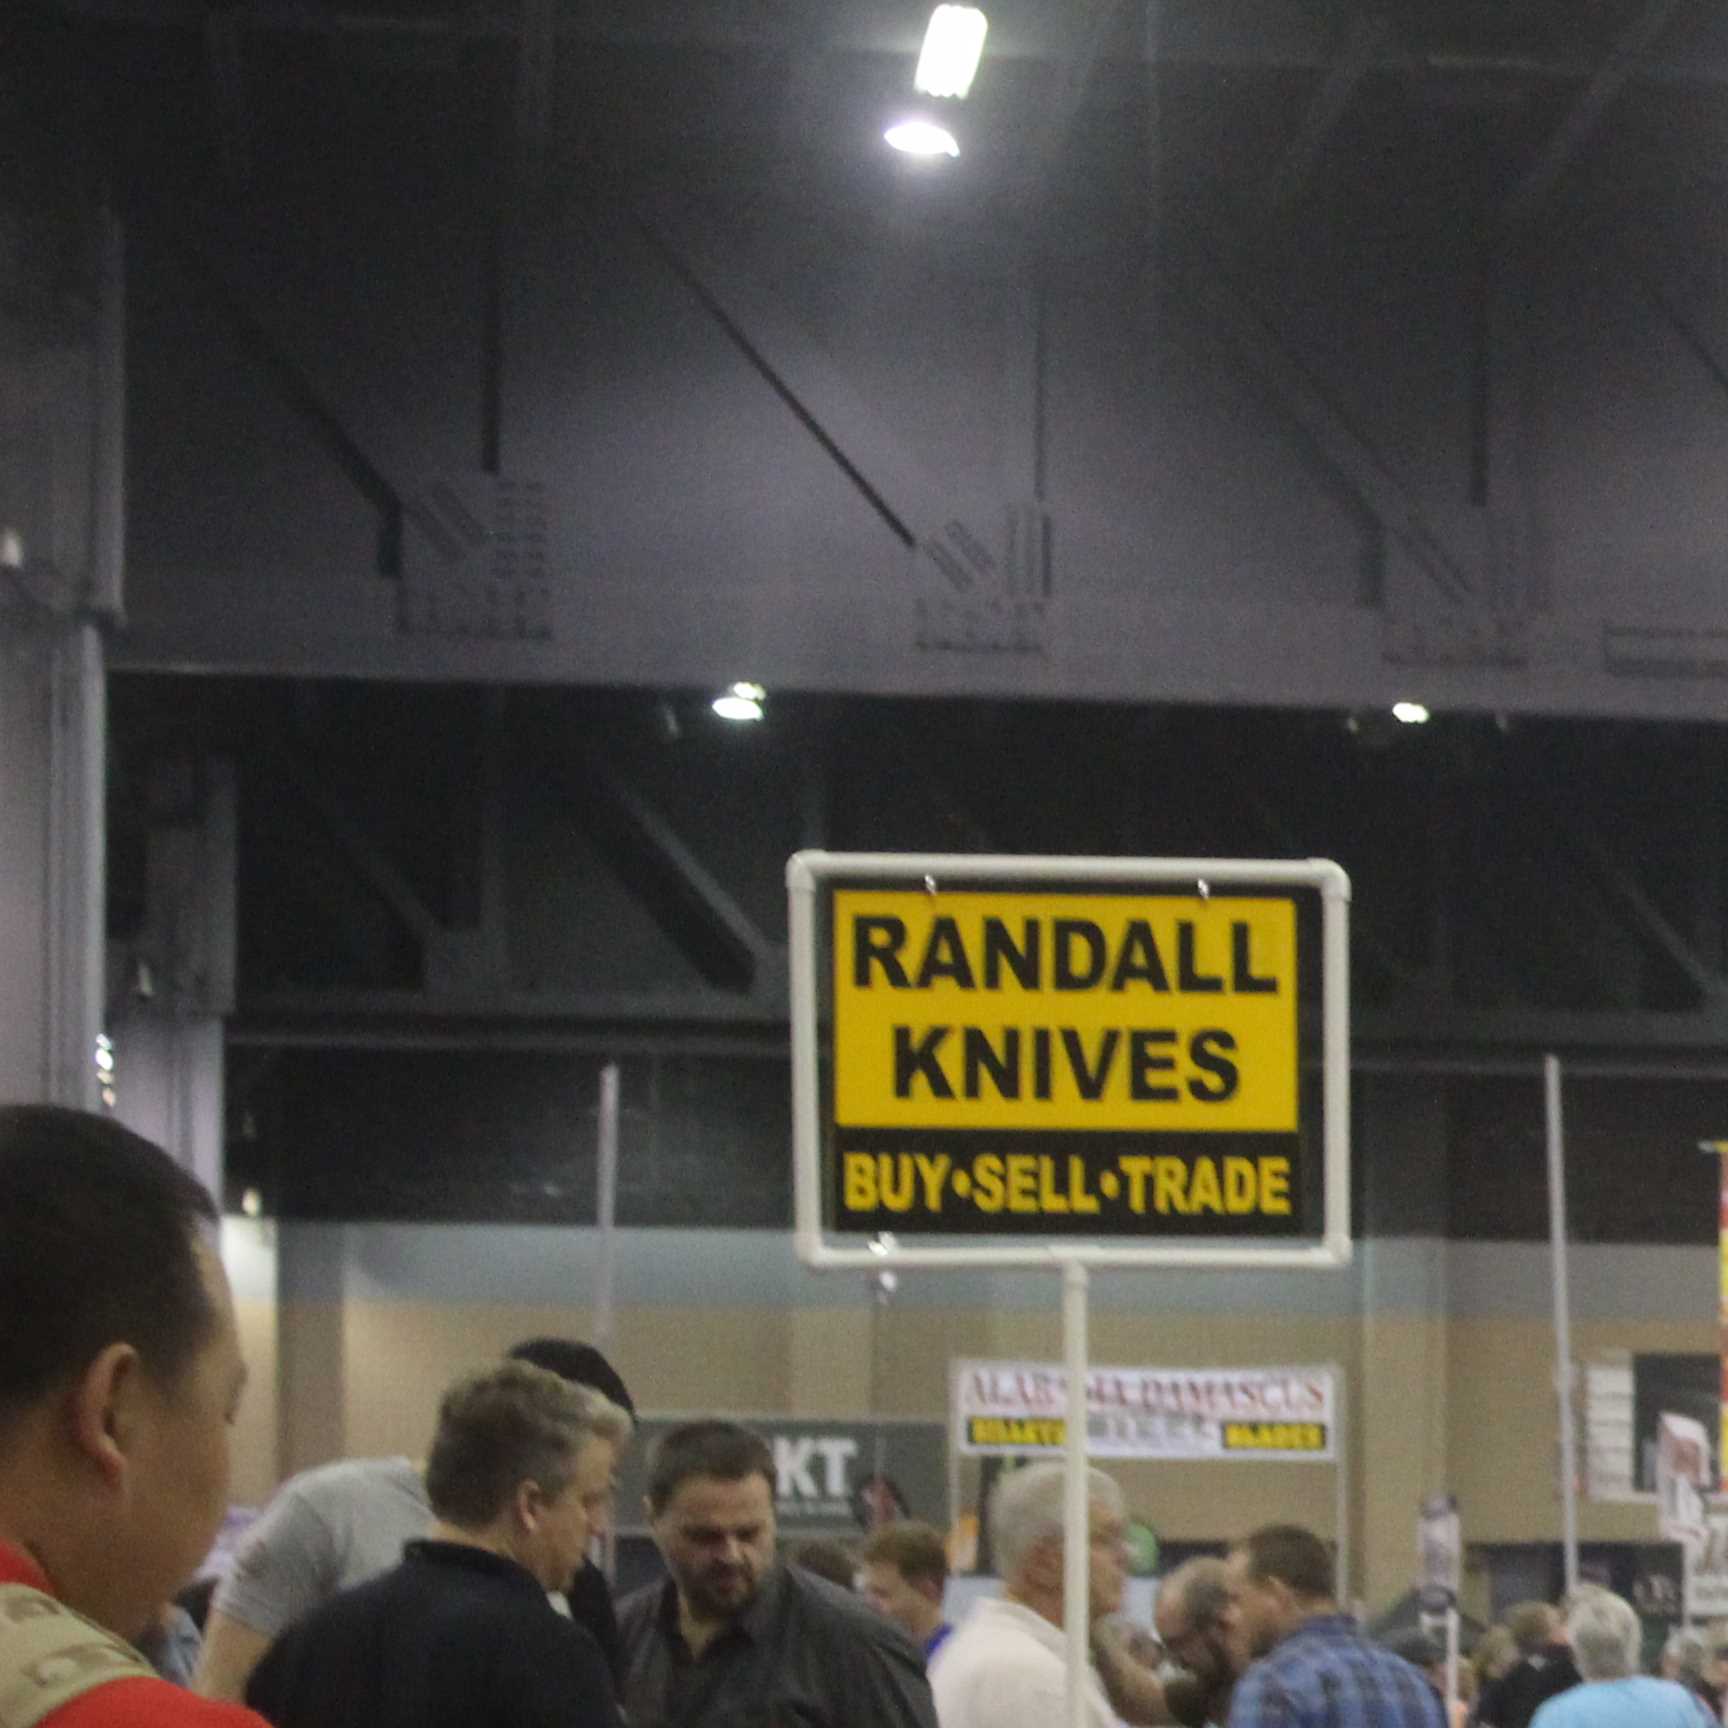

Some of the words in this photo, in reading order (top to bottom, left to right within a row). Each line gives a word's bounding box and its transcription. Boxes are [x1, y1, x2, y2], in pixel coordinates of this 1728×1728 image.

[852, 914, 1278, 994] RANDALL
[892, 1026, 1240, 1105] KNIVES
[773, 1437, 859, 1497] KT
